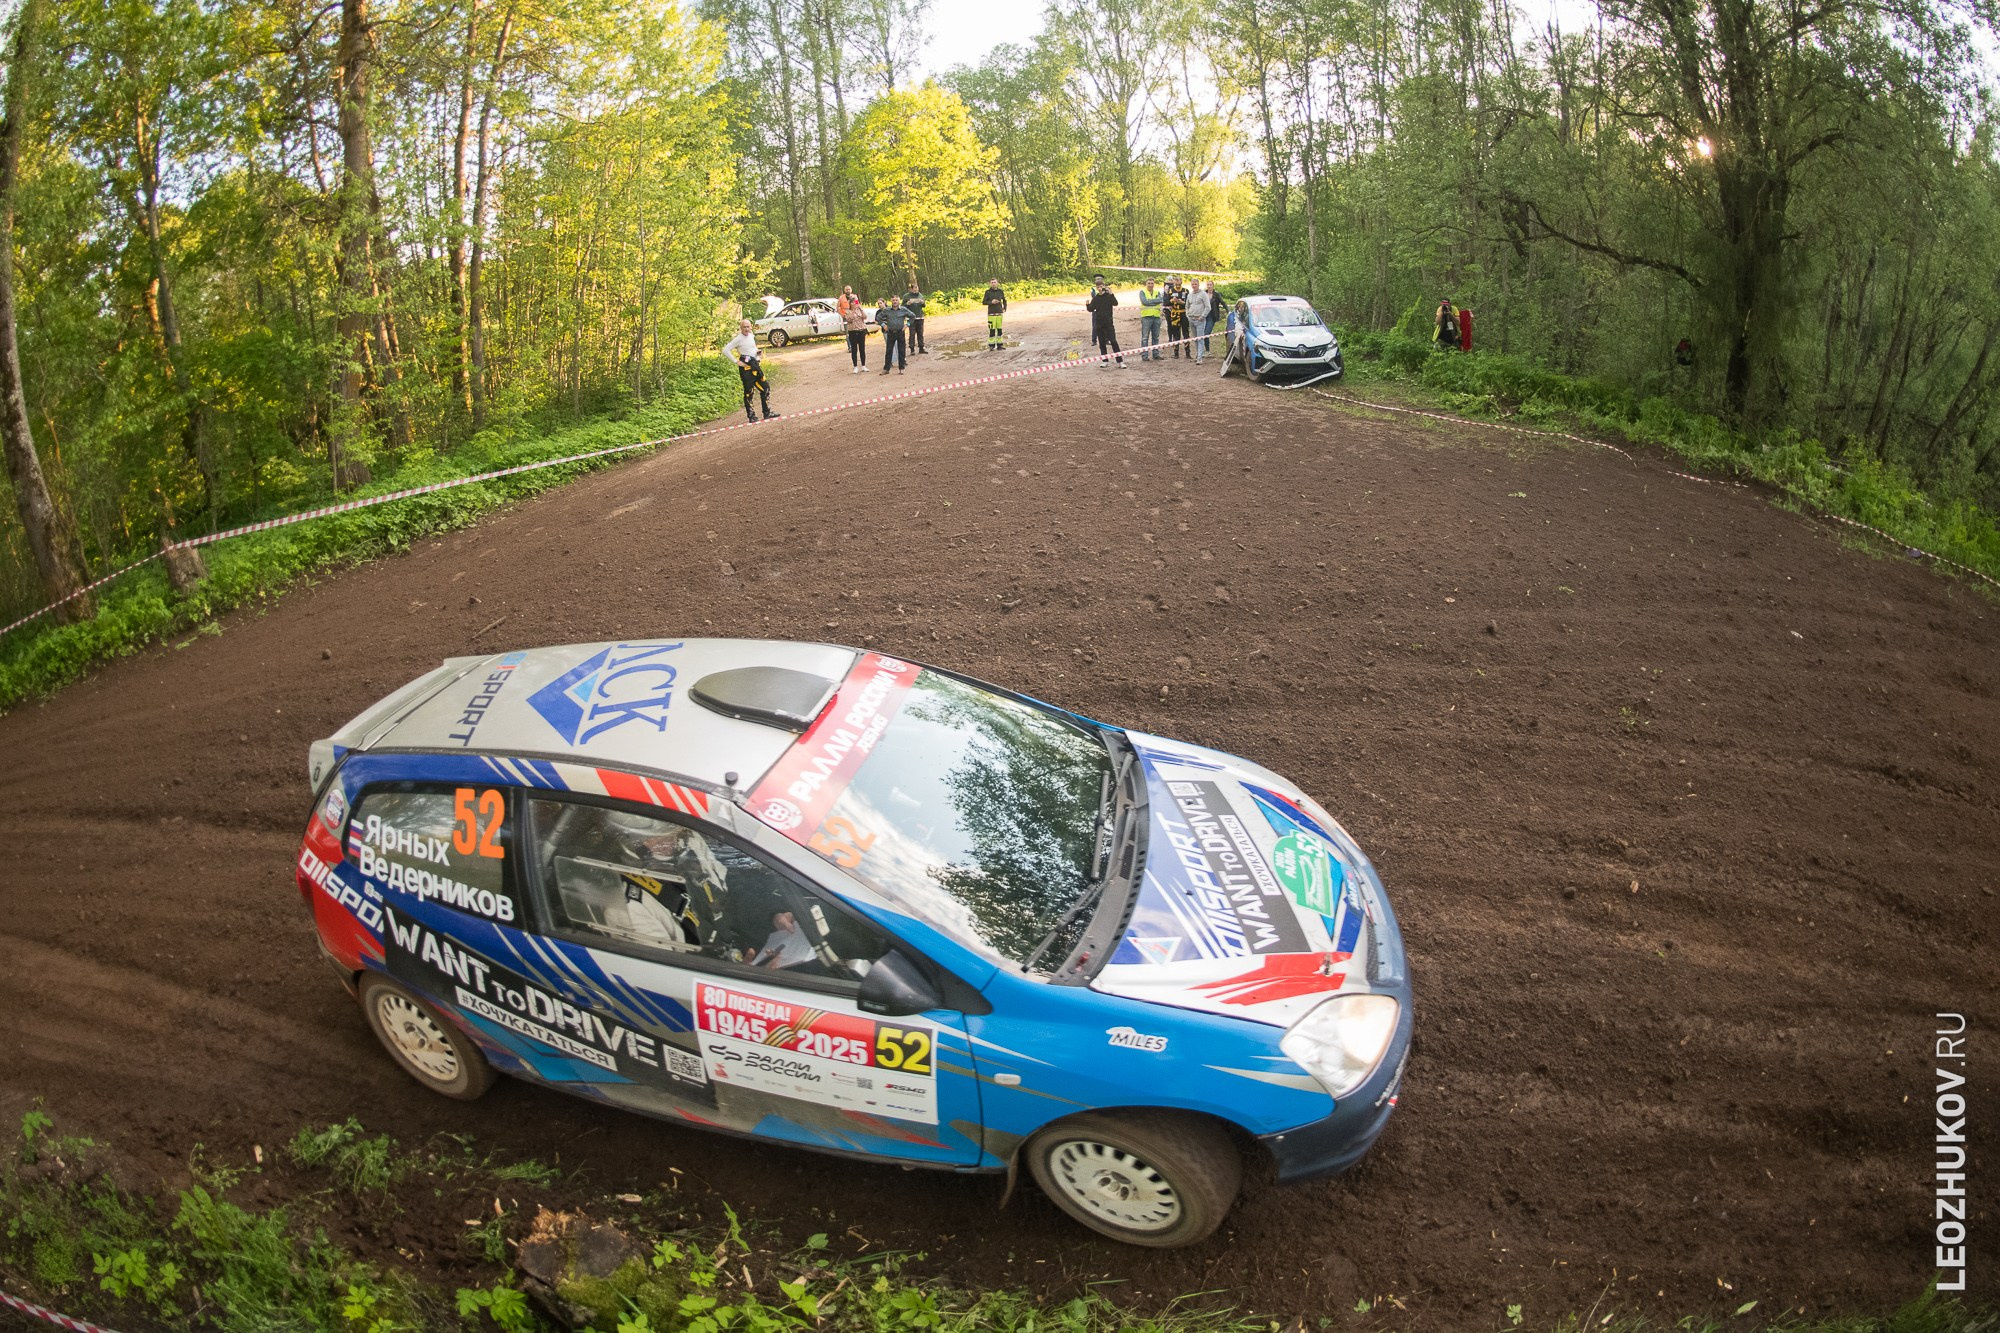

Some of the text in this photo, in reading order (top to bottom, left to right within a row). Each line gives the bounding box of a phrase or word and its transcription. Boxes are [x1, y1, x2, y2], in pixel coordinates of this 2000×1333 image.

[788, 670, 898, 802] РАЛЛИ РОССИИ
[365, 814, 450, 867] Ярных
[453, 788, 505, 859] 52
[809, 816, 877, 868] 52
[1296, 833, 1325, 858] 52
[359, 845, 515, 921] Ведерников
[1176, 798, 1280, 950] WANT TO DRIVE
[1285, 848, 1297, 879] РАЛЛИ
[386, 906, 659, 1067] WANT TO DRIVE
[704, 986, 791, 1021] 80 ПОБЕДА!
[461, 994, 611, 1067] #ХОЧУКАТАТЬСЯ
[705, 1008, 868, 1066] 1945 2025
[876, 1026, 931, 1074] 52
[1111, 1033, 1165, 1050] MILES
[745, 1059, 821, 1083] РОССИИ
[747, 1052, 811, 1072] РАЛЛИ
